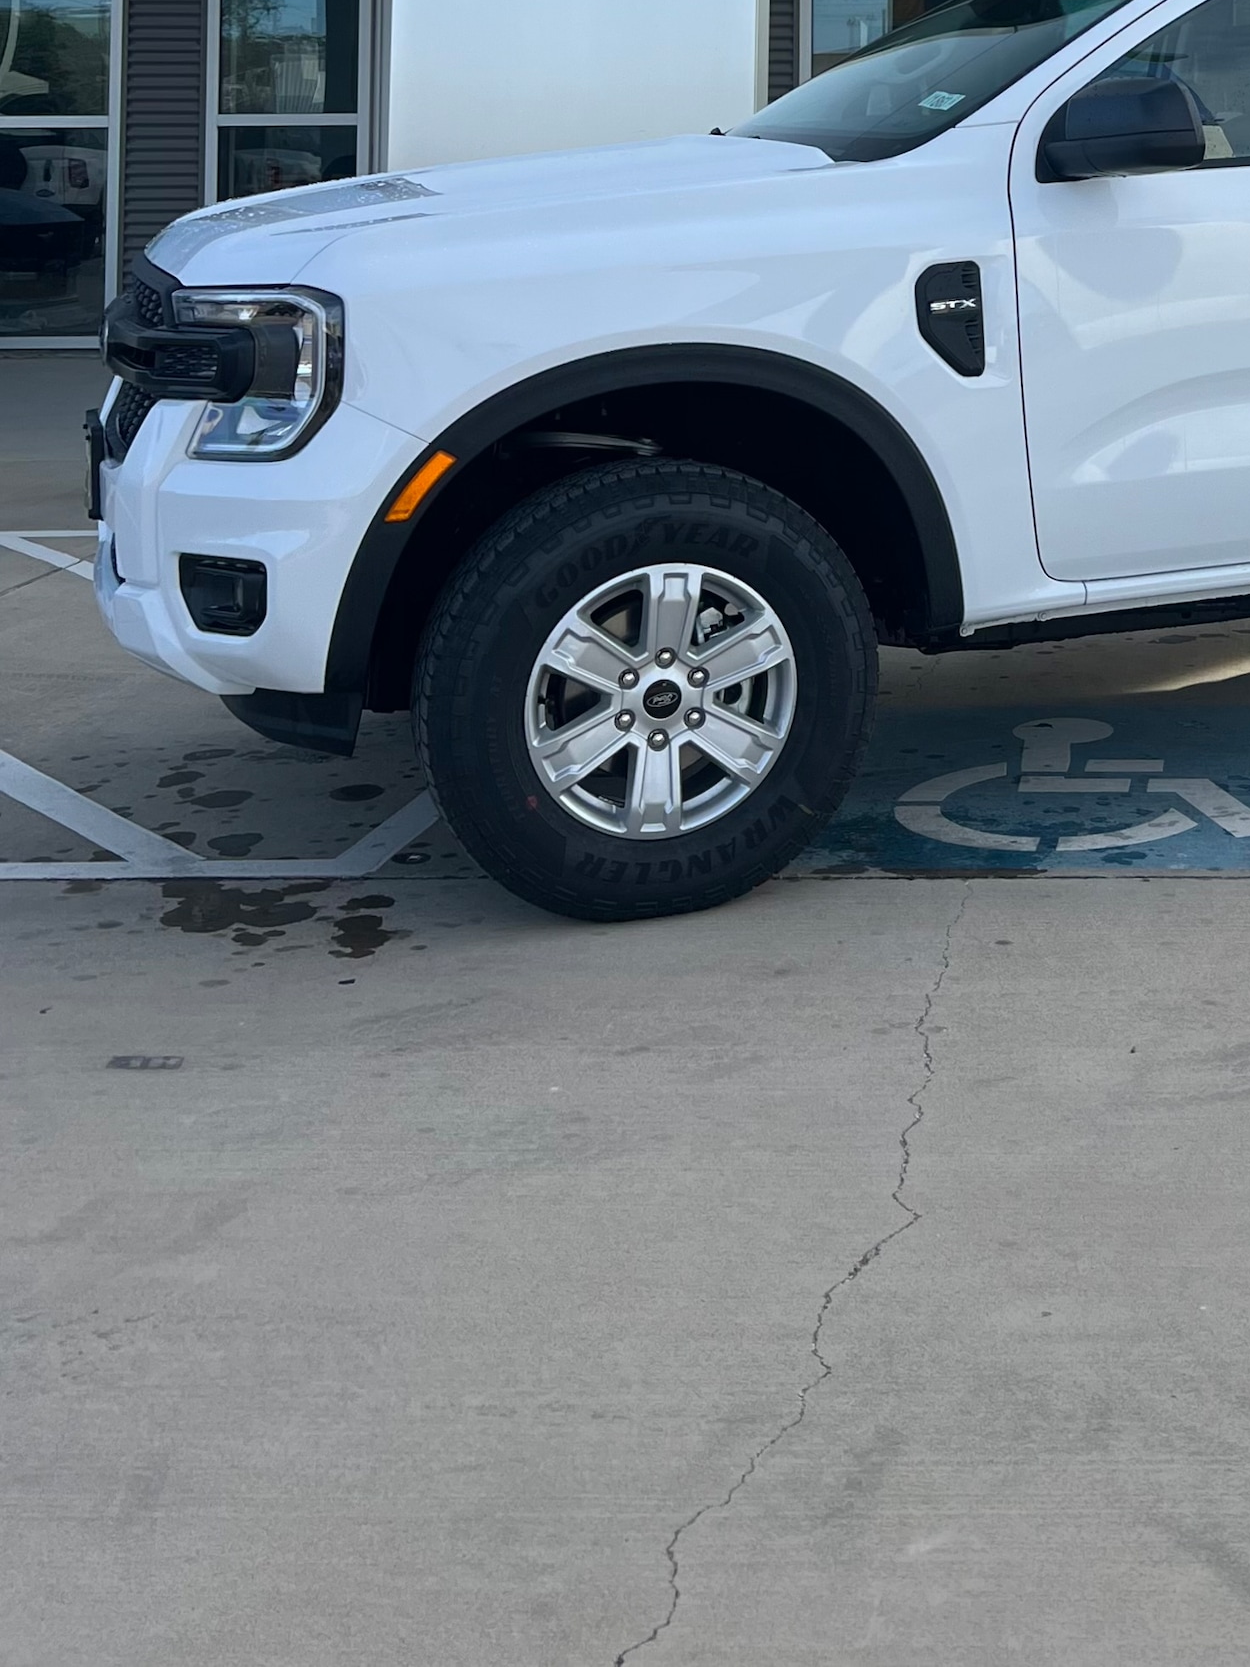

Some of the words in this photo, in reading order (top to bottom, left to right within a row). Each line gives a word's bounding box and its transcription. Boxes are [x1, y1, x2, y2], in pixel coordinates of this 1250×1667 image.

[930, 298, 976, 311] STX
[535, 515, 760, 610] GOODYEAR
[573, 793, 799, 885] WRANGLER
